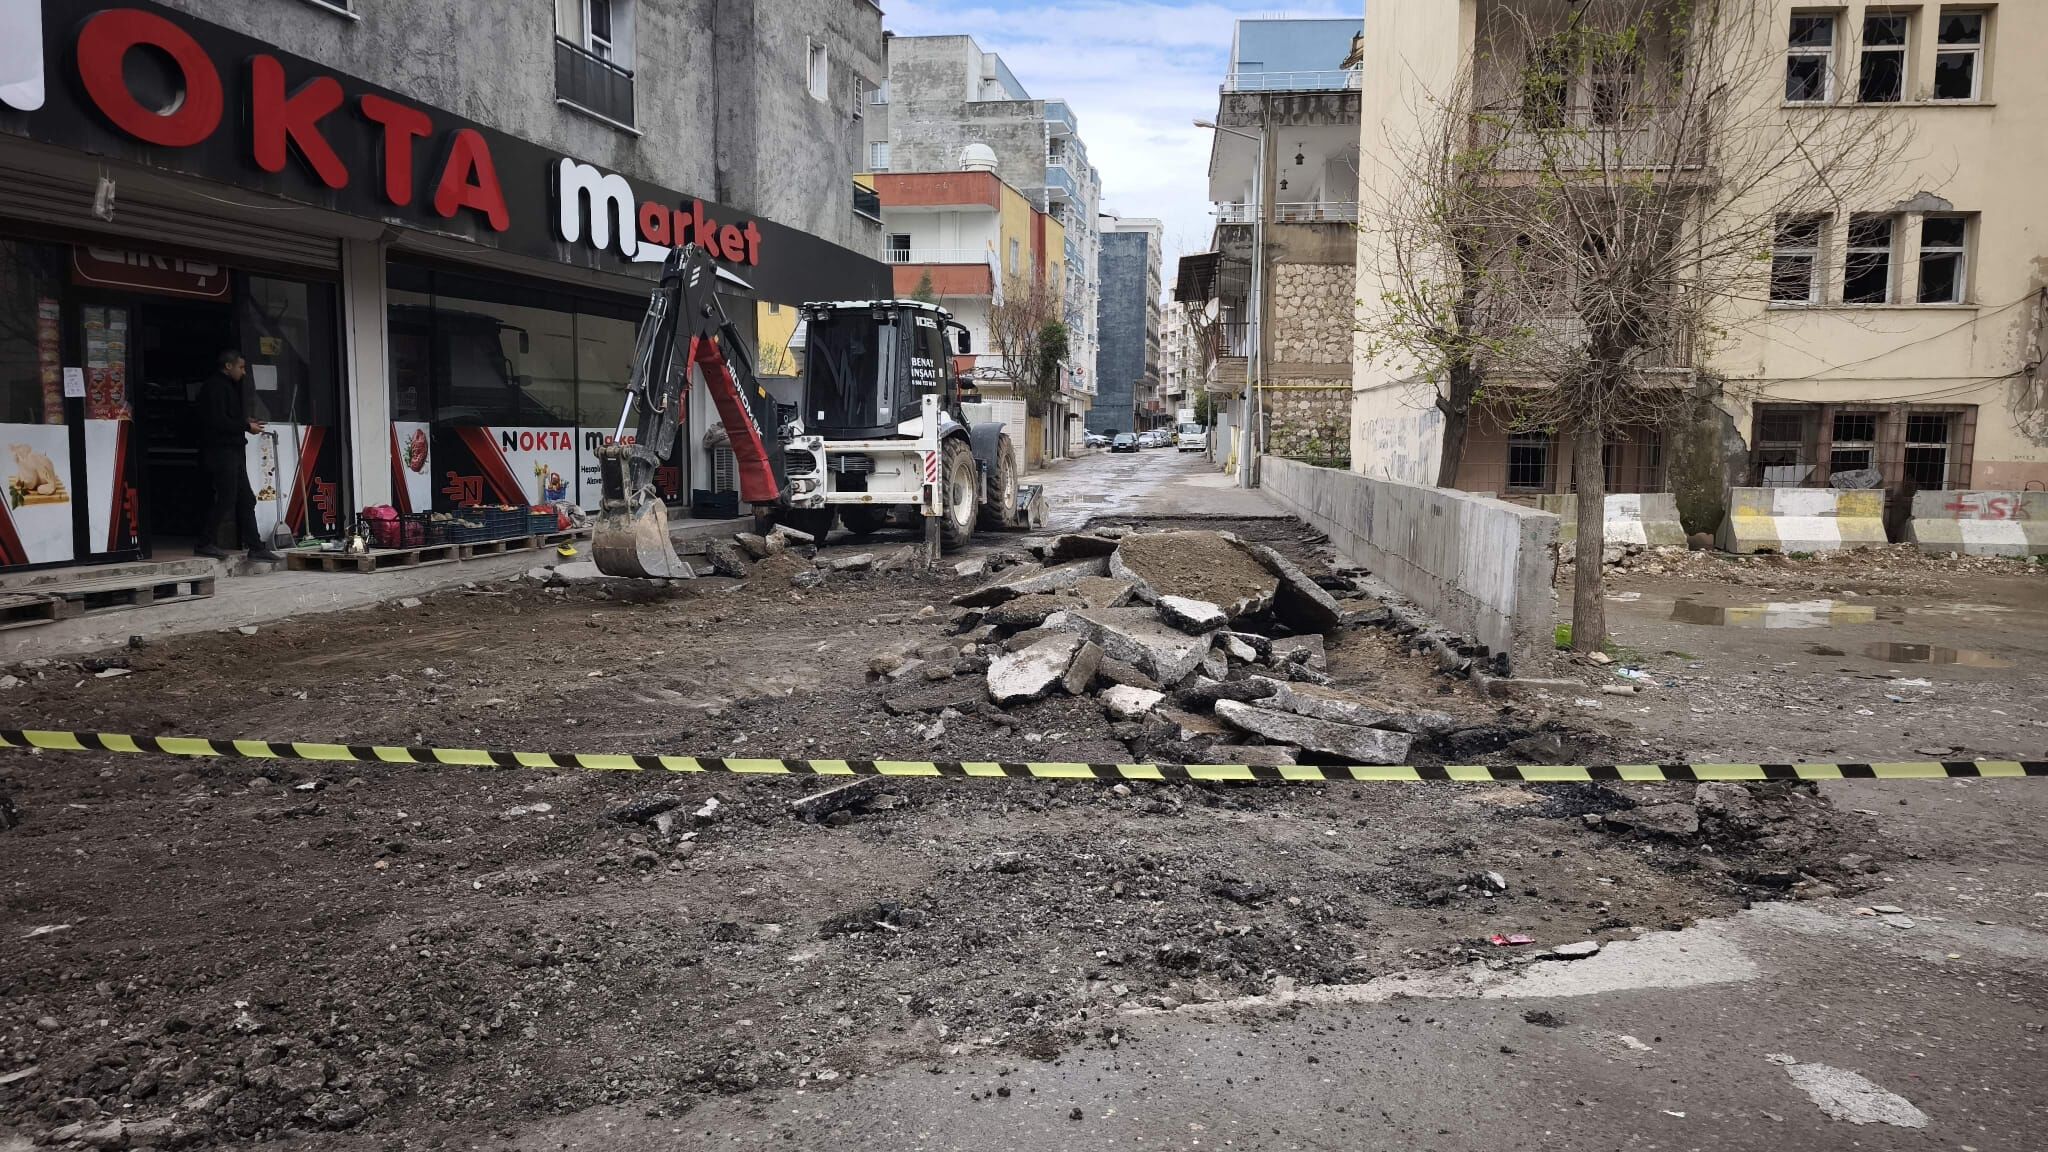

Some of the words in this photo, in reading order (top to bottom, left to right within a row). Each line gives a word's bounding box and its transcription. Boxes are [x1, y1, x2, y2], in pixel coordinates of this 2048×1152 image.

[560, 157, 761, 266] market
[911, 357, 934, 368] BENAY
[502, 430, 572, 452] NOKTA
[585, 431, 637, 451] make
